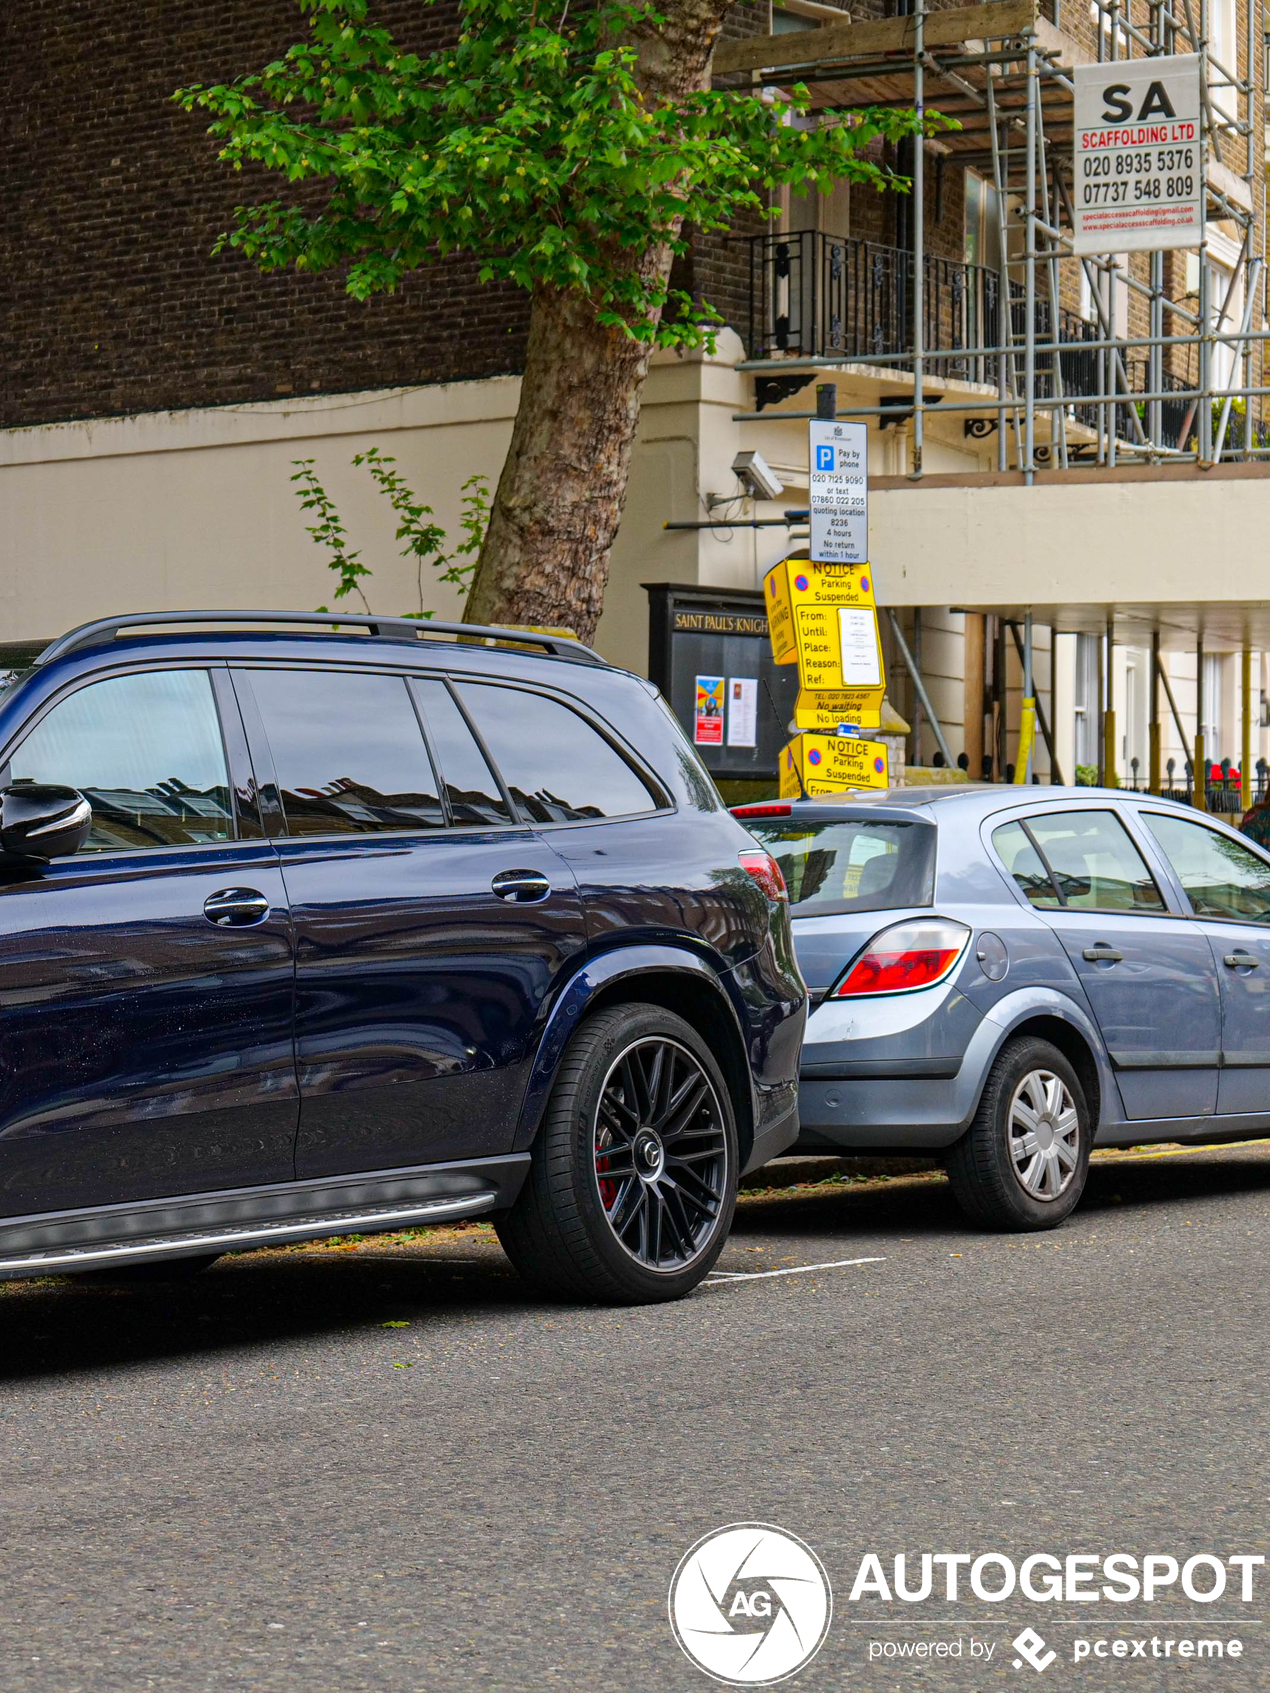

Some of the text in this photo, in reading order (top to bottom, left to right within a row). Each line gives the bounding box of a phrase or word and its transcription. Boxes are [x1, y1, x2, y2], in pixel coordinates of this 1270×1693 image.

[1101, 81, 1176, 123] SA
[1082, 123, 1195, 149] SCAFFOLDING LTD
[1084, 149, 1193, 177] 020 8935 5376
[1084, 175, 1193, 204] 07737 548 809
[838, 449, 860, 459] Pay by
[839, 460, 859, 468] phone
[812, 474, 864, 485] 020 7125 9090
[836, 487, 849, 495] text
[811, 495, 865, 505] 07860 022 205
[813, 507, 865, 517] quoting location
[830, 518, 848, 527] 8236
[833, 529, 852, 538] hours
[823, 540, 855, 549] No return
[819, 550, 839, 558] within
[845, 551, 860, 559] hour
[813, 562, 855, 575] NOTICE
[821, 579, 852, 590] Parking
[815, 592, 859, 602] Suspended
[676, 613, 704, 629] SAINT
[800, 611, 827, 621] From:
[802, 627, 828, 637] Until:
[804, 642, 831, 652] Place:
[806, 658, 841, 669] Reason:
[807, 674, 825, 684] Ref:
[828, 692, 840, 700] 020
[817, 701, 862, 712] No waiting
[817, 713, 862, 725] No loading
[827, 739, 869, 756] NOTICE
[833, 756, 864, 770] Parking
[826, 768, 870, 782] Suspended
